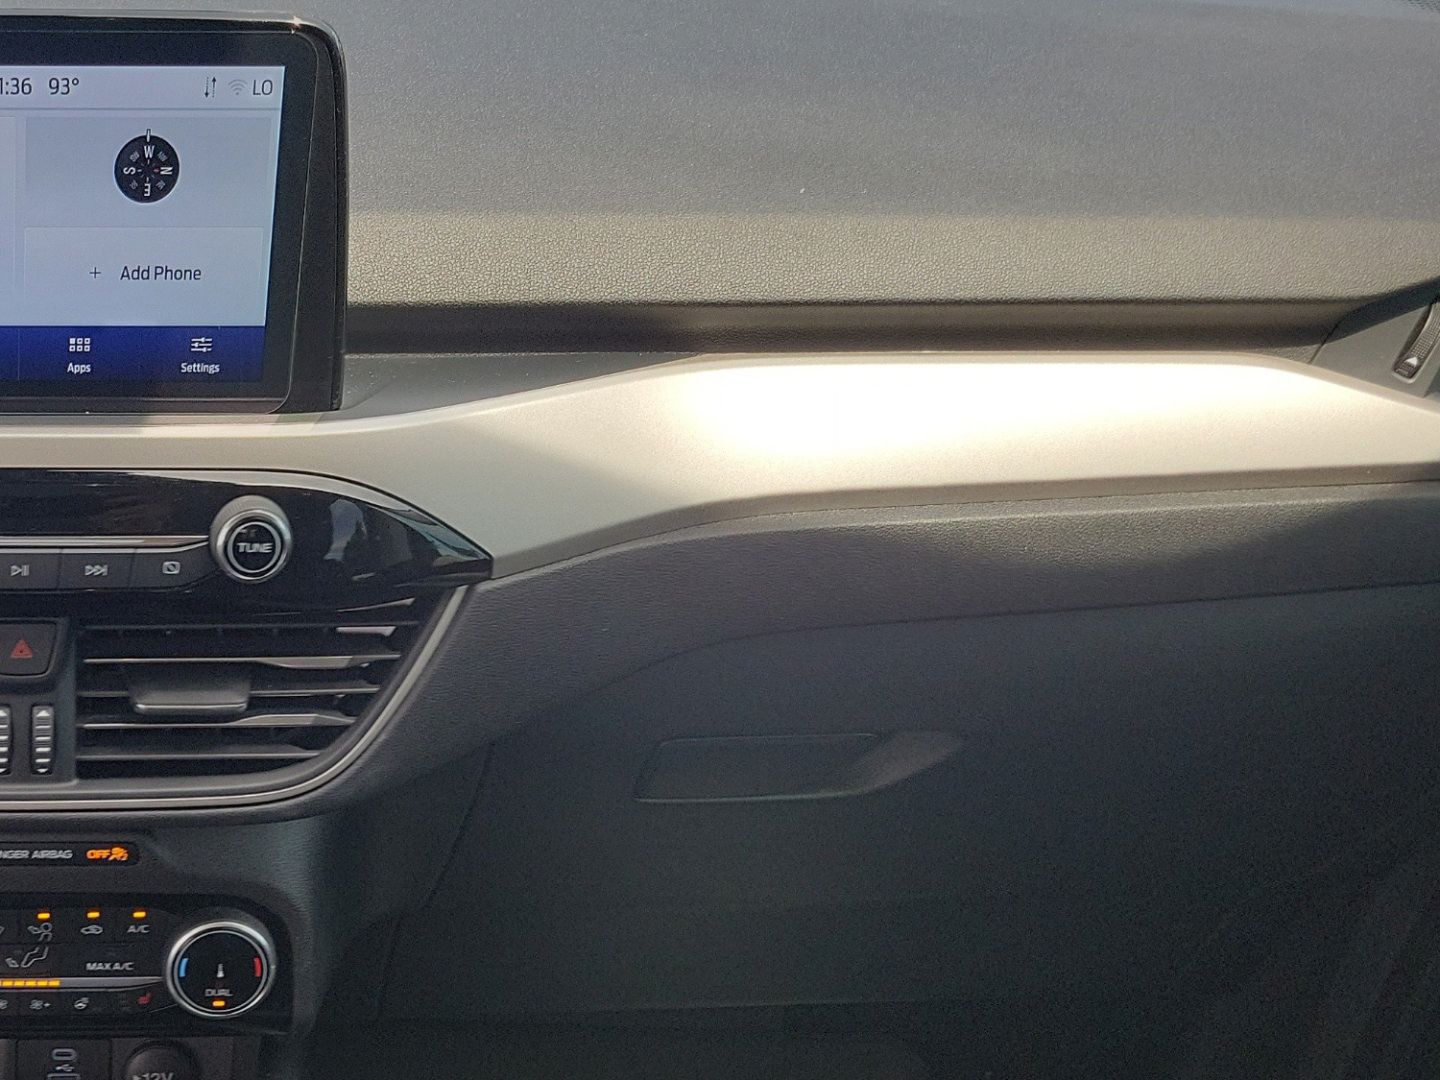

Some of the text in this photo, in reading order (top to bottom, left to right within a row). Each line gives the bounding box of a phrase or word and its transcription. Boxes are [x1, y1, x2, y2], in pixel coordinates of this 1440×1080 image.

[253, 78, 273, 97] LO
[143, 145, 155, 159] W
[120, 265, 202, 282] Add Phone
[67, 362, 91, 377] Apps
[180, 362, 220, 377] Settings
[236, 542, 273, 553] TUNE
[30, 849, 73, 860] AIRBAG
[86, 849, 110, 860] OFF
[127, 924, 150, 934] A/C
[86, 961, 135, 972] MAX A/C
[205, 988, 233, 997] DUAL
